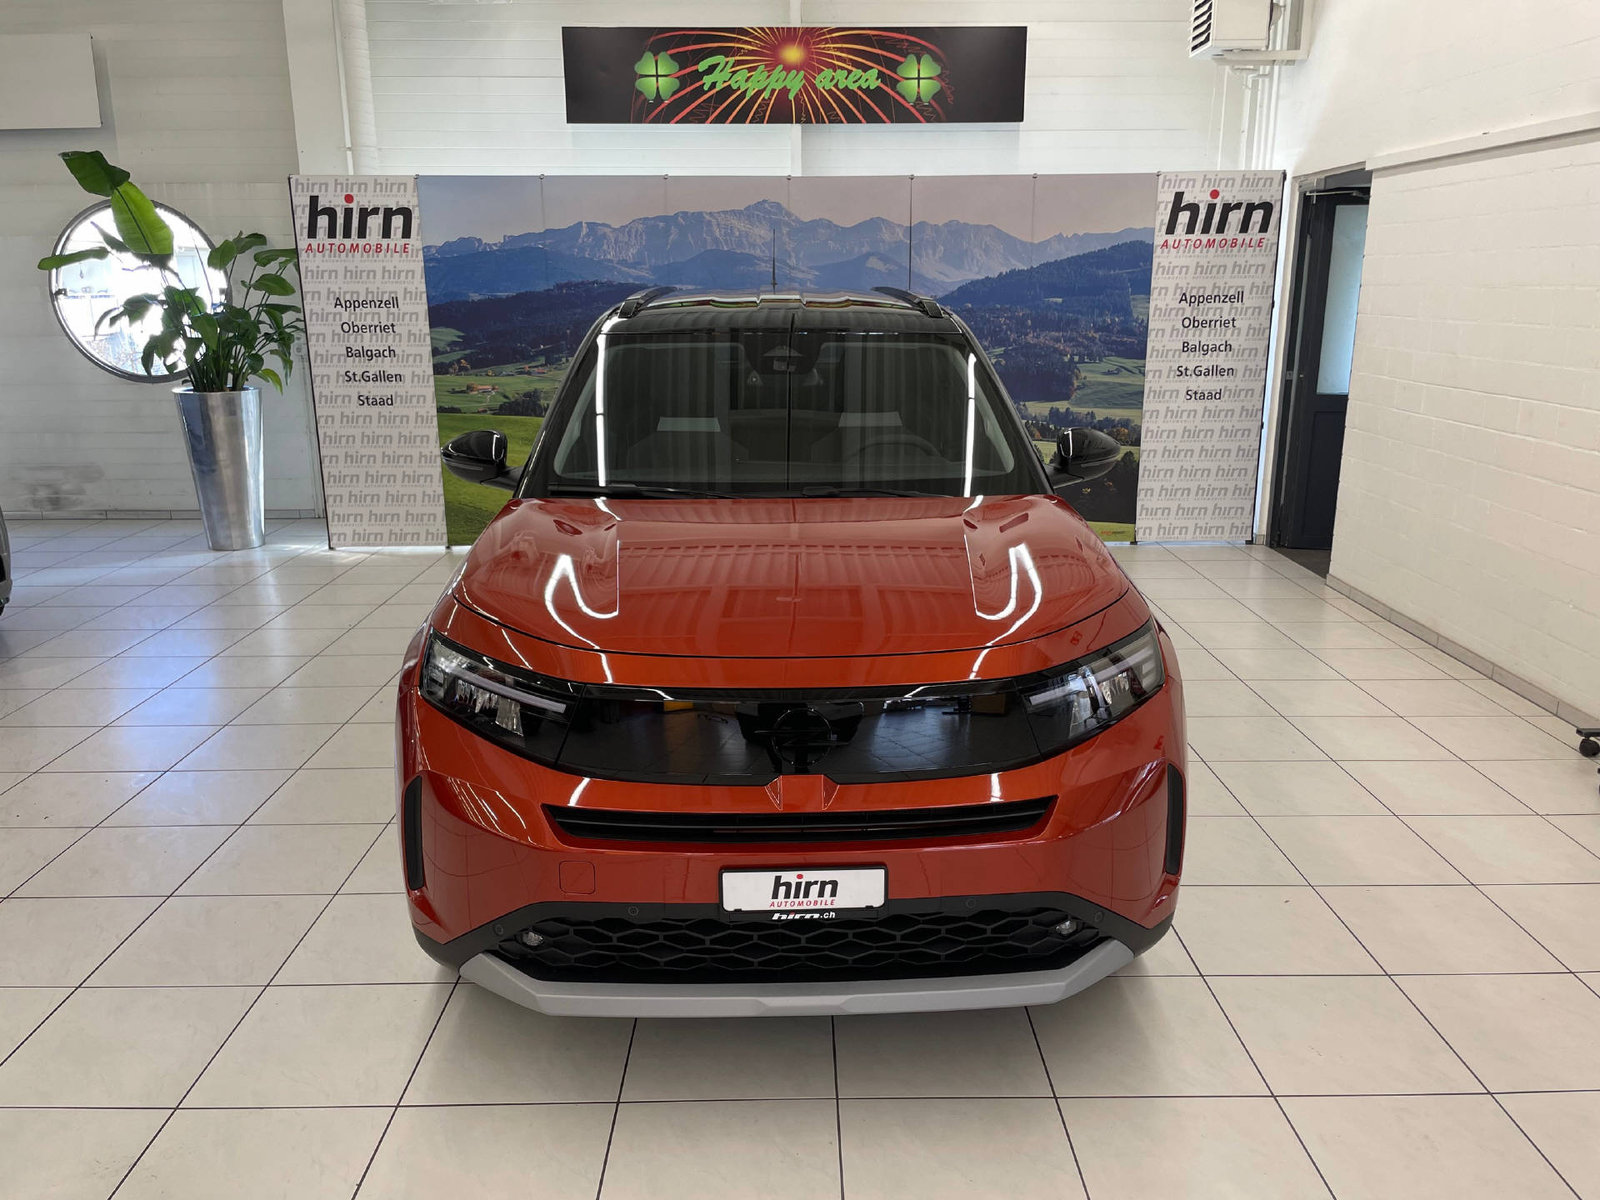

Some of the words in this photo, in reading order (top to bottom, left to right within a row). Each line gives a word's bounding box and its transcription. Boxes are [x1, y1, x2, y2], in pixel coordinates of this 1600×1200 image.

[698, 55, 804, 99] Happy
[815, 66, 881, 91] area
[295, 178, 328, 193] hirn
[334, 178, 368, 193] hirn
[373, 178, 407, 193] hirn
[1161, 175, 1196, 188] hirn
[1201, 174, 1236, 188] hirn
[1241, 173, 1274, 187] hirn
[308, 194, 412, 239] hirn
[1165, 189, 1273, 234] hirn
[305, 243, 409, 253] AUTOMOBILE
[1160, 238, 1265, 249] AUTOMOBILE
[304, 266, 338, 280] hirn
[343, 266, 376, 280] hirn
[382, 266, 415, 279] hirn
[1155, 262, 1190, 275] hirn
[1194, 261, 1227, 275] hirn
[1231, 261, 1265, 275] hirn
[404, 287, 425, 300] hir
[1249, 282, 1274, 295] hir
[334, 297, 399, 312] Appenzell
[1179, 291, 1244, 306] Appenzell
[309, 309, 342, 322] hirn
[386, 309, 418, 322] hirn
[1153, 305, 1185, 317] hirn
[1229, 304, 1262, 316] hirn
[341, 322, 396, 333] Oberriet
[1182, 316, 1236, 328] Oberriet
[407, 330, 429, 342] hir
[1246, 324, 1270, 337] hir
[346, 346, 396, 361] Balgach
[1182, 341, 1232, 355] Balgach
[345, 370, 402, 382] St.Gallen
[411, 370, 433, 383] hir
[1177, 365, 1234, 376] St.Gallen
[1243, 365, 1266, 378] hir
[319, 391, 351, 404] hirn
[1147, 387, 1179, 399] hirn
[1186, 389, 1222, 400] Staad
[358, 395, 394, 406] Staad
[340, 412, 372, 424] hirn
[378, 411, 409, 424] hirn
[415, 411, 437, 424] hir
[1164, 407, 1197, 419] hirn
[1202, 406, 1235, 418] hirn
[1239, 406, 1262, 418] hir
[323, 432, 355, 444] hirn
[361, 432, 392, 444] hirn
[398, 431, 430, 444] hirn
[1144, 426, 1177, 439] hirn
[1181, 426, 1214, 439] hirn
[1219, 426, 1251, 438] hirn
[344, 452, 376, 464] hirn
[381, 451, 413, 464] hirn
[418, 451, 440, 463] hir
[1162, 445, 1194, 458] hirn
[1199, 445, 1232, 458] hirn
[1236, 445, 1259, 458] hir
[328, 472, 359, 484] hirn
[365, 471, 396, 483] hirn
[401, 471, 433, 483] hirn
[1142, 466, 1174, 478] hirn
[1179, 465, 1211, 477] hirn
[1216, 465, 1248, 477] hirn
[348, 491, 380, 503] hirn
[385, 490, 416, 503] hirn
[421, 490, 443, 503] hir
[1158, 485, 1191, 497] hirn
[1195, 484, 1228, 496] hirn
[1232, 484, 1255, 496] hir
[332, 510, 363, 522] hirn
[369, 510, 400, 522] hirn
[405, 510, 437, 522] hirn
[1139, 504, 1171, 516] hirn
[1176, 504, 1208, 516] hirn
[1212, 504, 1245, 516] hirn
[352, 529, 383, 541] hirn
[389, 529, 420, 541] hirn
[425, 529, 447, 541] hir
[1157, 523, 1188, 536] hirn
[1193, 523, 1225, 535] hirn
[1229, 522, 1252, 535] hir
[772, 874, 838, 900] hirn
